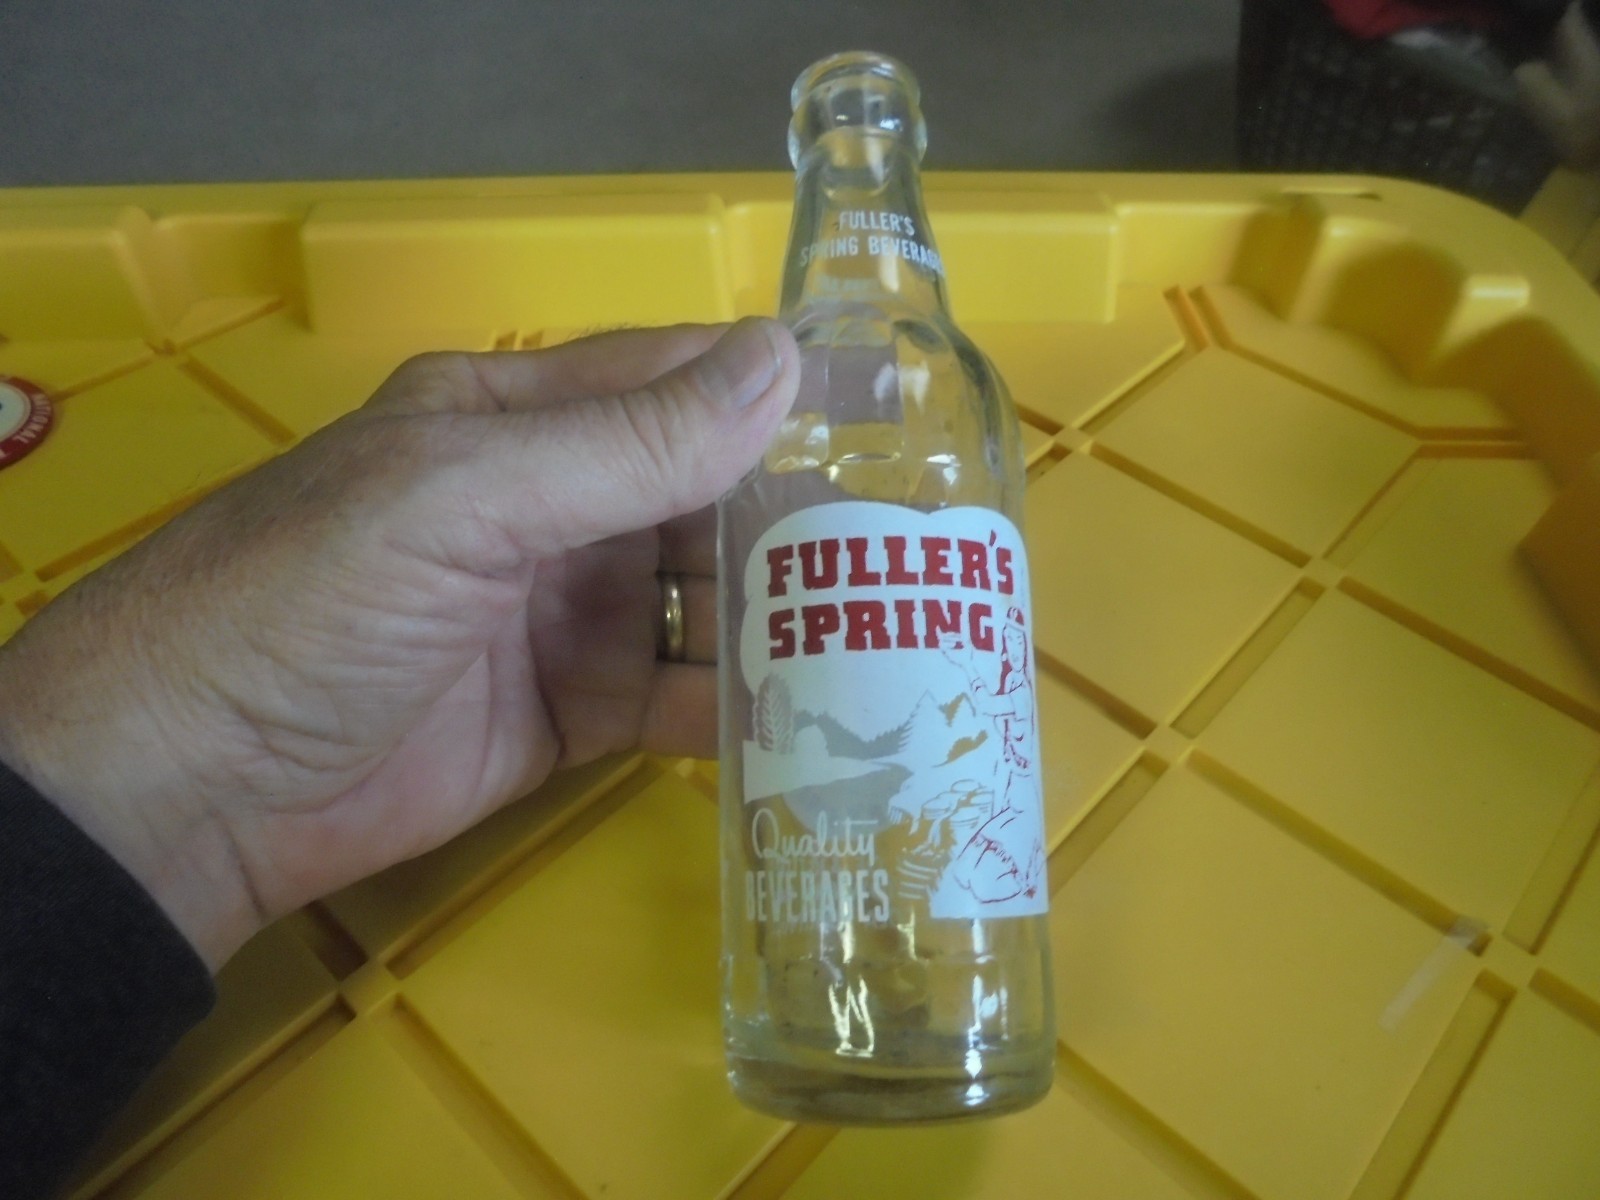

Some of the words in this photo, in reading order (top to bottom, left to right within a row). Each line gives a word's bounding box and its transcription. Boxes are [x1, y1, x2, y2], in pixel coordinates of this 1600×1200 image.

[838, 210, 916, 236] FULLER'S
[766, 529, 1014, 598] FULLER'S
[768, 599, 996, 661] SPRING
[752, 807, 879, 867] Quality
[745, 868, 891, 924] BEVERAGES
